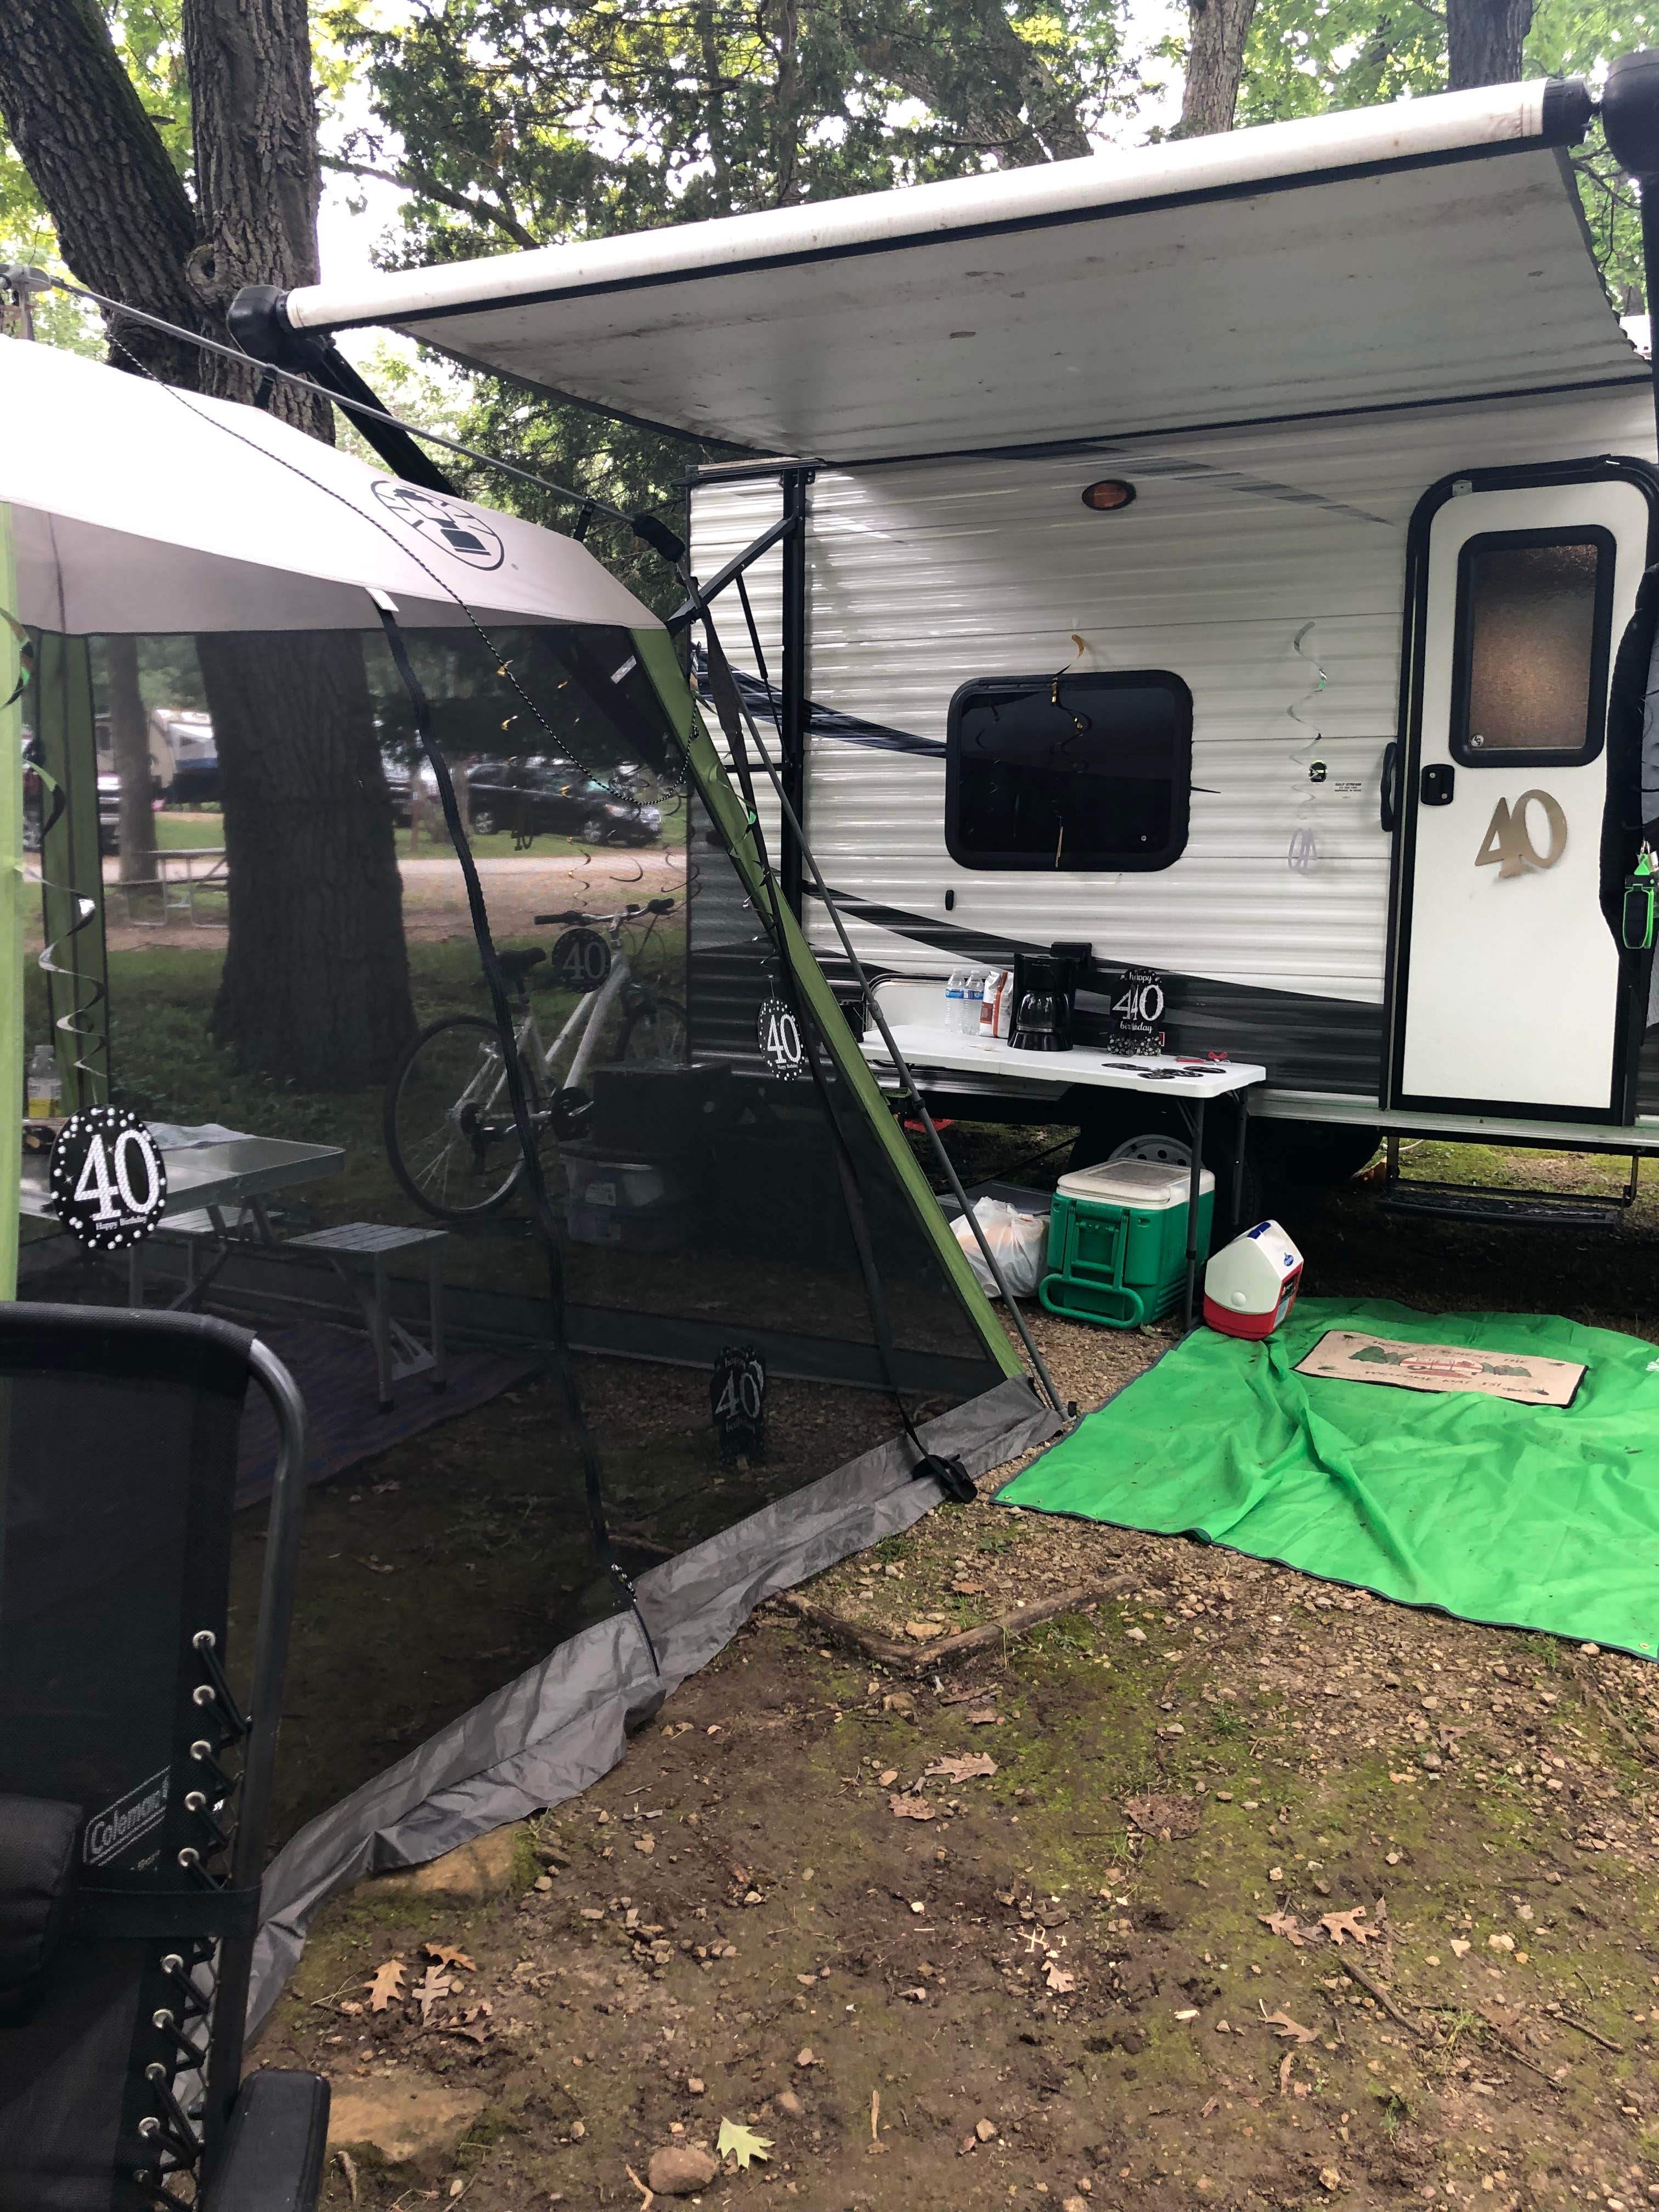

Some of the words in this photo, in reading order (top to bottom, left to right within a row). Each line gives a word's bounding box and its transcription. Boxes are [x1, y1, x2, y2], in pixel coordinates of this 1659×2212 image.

[1475, 789, 1567, 878] 40
[562, 941, 606, 980] 40
[767, 1014, 802, 1064] 40
[74, 1129, 160, 1221] 40
[715, 1370, 760, 1419] 40
[91, 1789, 162, 1855] Coleman
